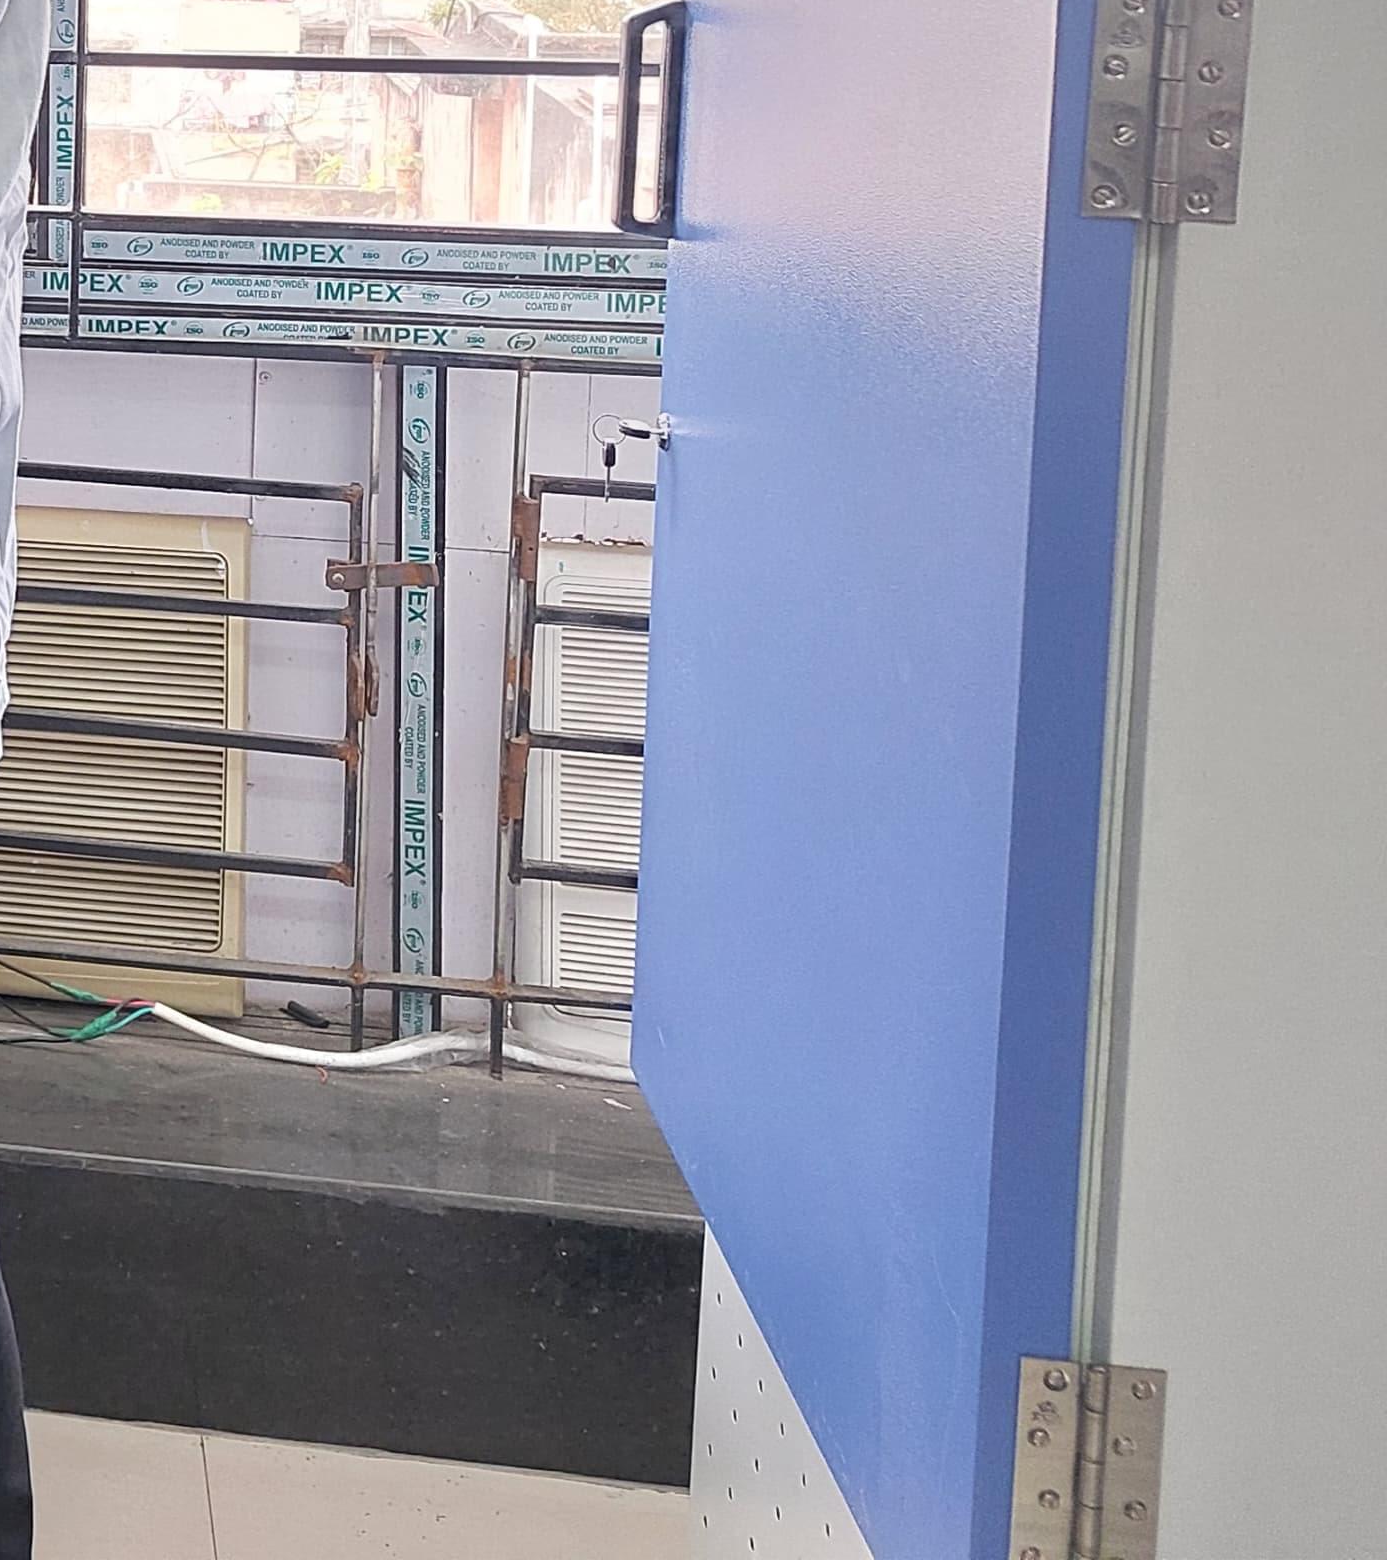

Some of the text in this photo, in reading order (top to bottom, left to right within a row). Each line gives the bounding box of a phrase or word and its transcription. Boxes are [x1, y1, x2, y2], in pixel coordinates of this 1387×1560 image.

[54, 94, 75, 172] IMPEX
[55, 176, 65, 205] OWDER
[159, 238, 256, 251] ANODISED AND POWDER
[184, 250, 231, 259] COATED BY
[261, 241, 347, 264] IMPEX
[362, 251, 380, 260] ISO
[436, 248, 537, 262] ANODISED AND POWDER
[462, 261, 510, 271] COATED BY
[543, 252, 632, 274] IMPEX
[138, 280, 159, 289] ISO
[210, 278, 252, 289] ANODISED
[253, 279, 272, 289] AND
[236, 289, 283, 300] COATED BY
[315, 281, 404, 304] IMPEX
[498, 290, 600, 302] ANODISED AND POWDER
[524, 302, 573, 313] COATED BY
[257, 322, 356, 334] ANODISED AND POWDER
[363, 326, 449, 347] IMPEX
[467, 336, 485, 344] ISO
[543, 333, 648, 346] ANODISED AND POWDER
[571, 345, 620, 356] COATED BY
[415, 379, 426, 400] ISO
[419, 449, 431, 540] ANODISED AND POWDER
[407, 505, 419, 517] BY
[404, 726, 414, 769] COATED BY
[416, 703, 427, 795] ANODISED AND POWDER
[403, 799, 427, 878] IMPEX
[411, 889, 421, 909] ISO
